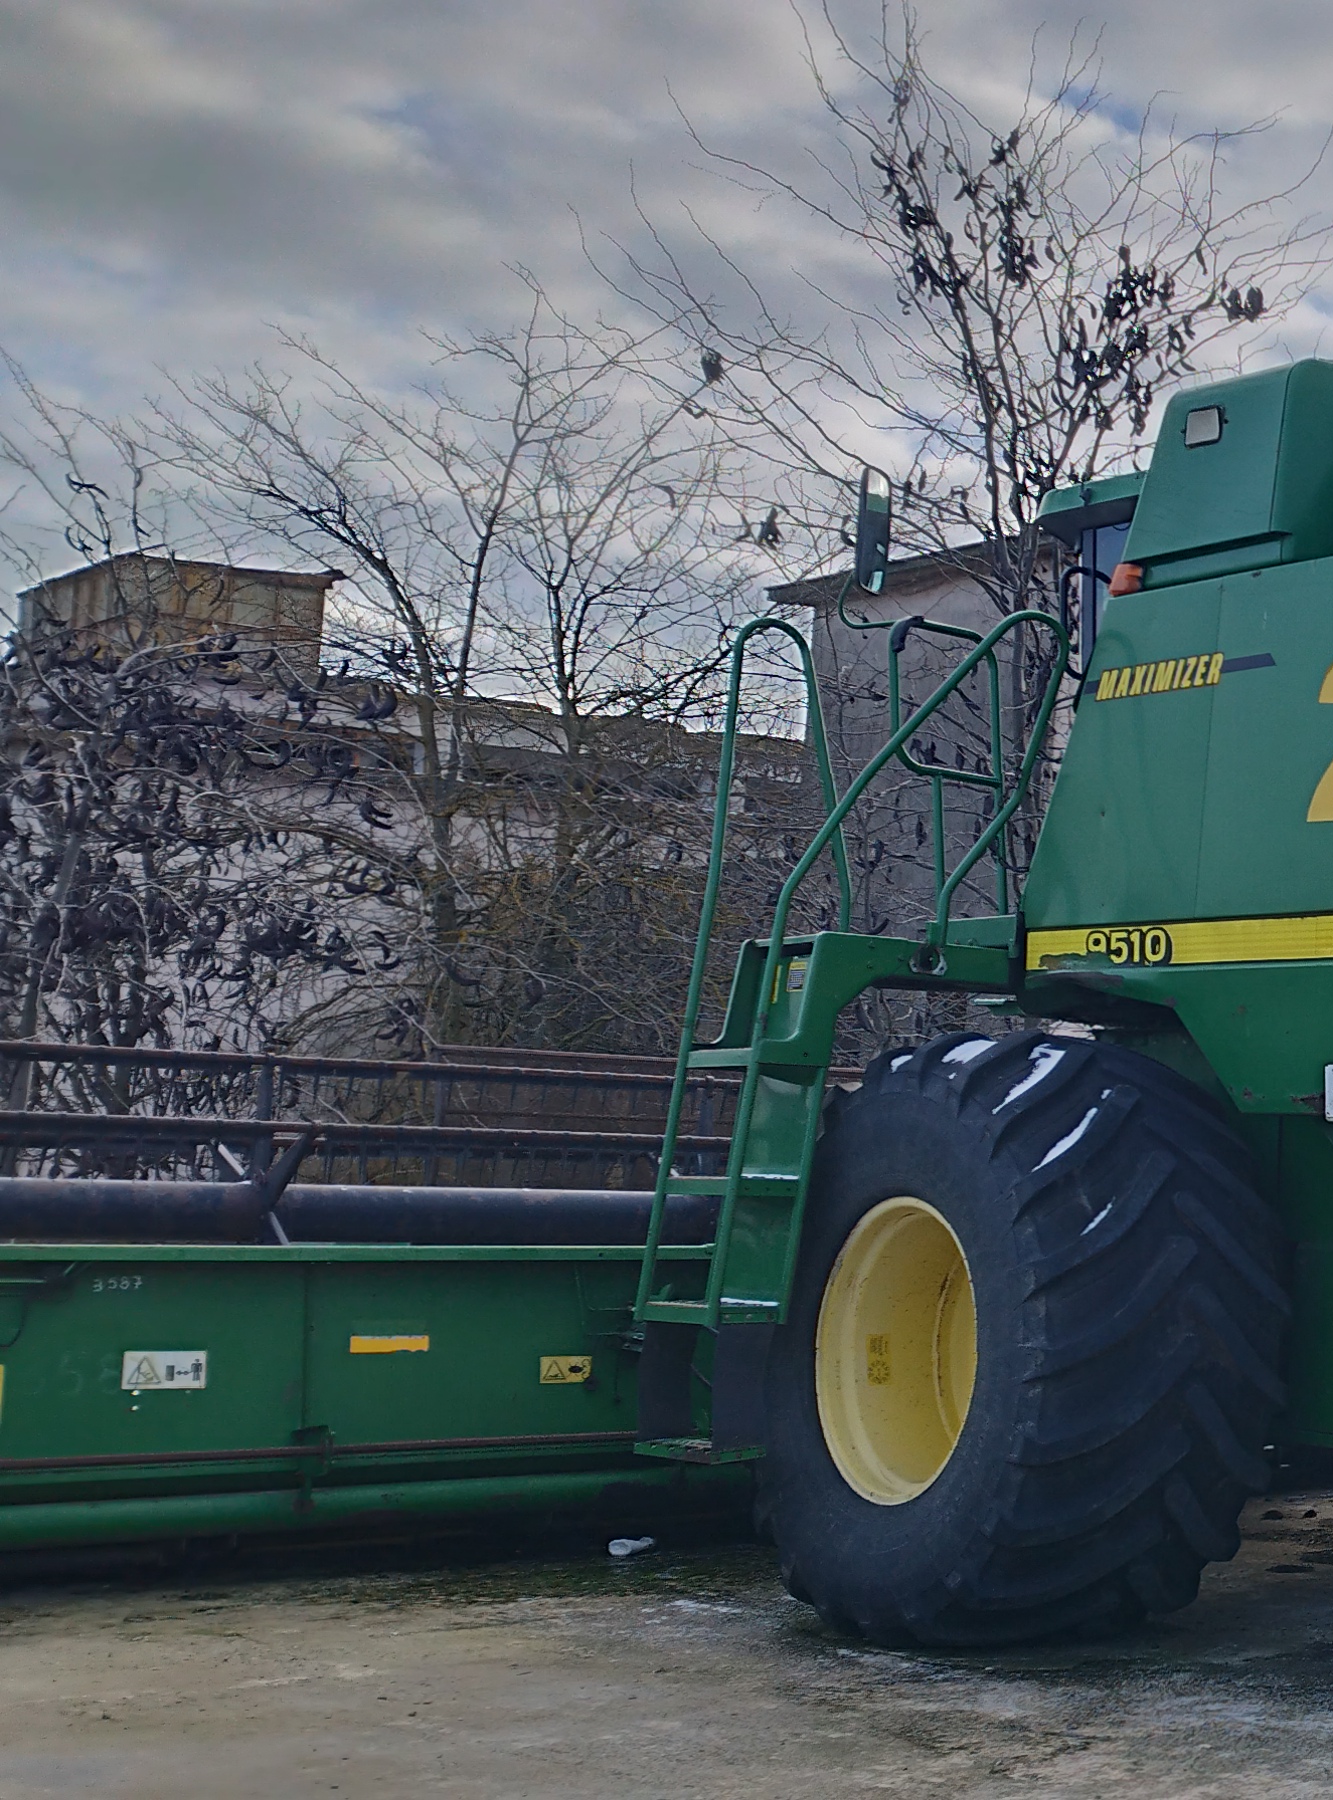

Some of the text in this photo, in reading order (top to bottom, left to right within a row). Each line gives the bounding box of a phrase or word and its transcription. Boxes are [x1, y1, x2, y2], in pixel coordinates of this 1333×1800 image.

[1095, 652, 1224, 702] MAXIMIZER
[1086, 926, 1172, 966] 9510
[92, 1275, 143, 1293] 3587
